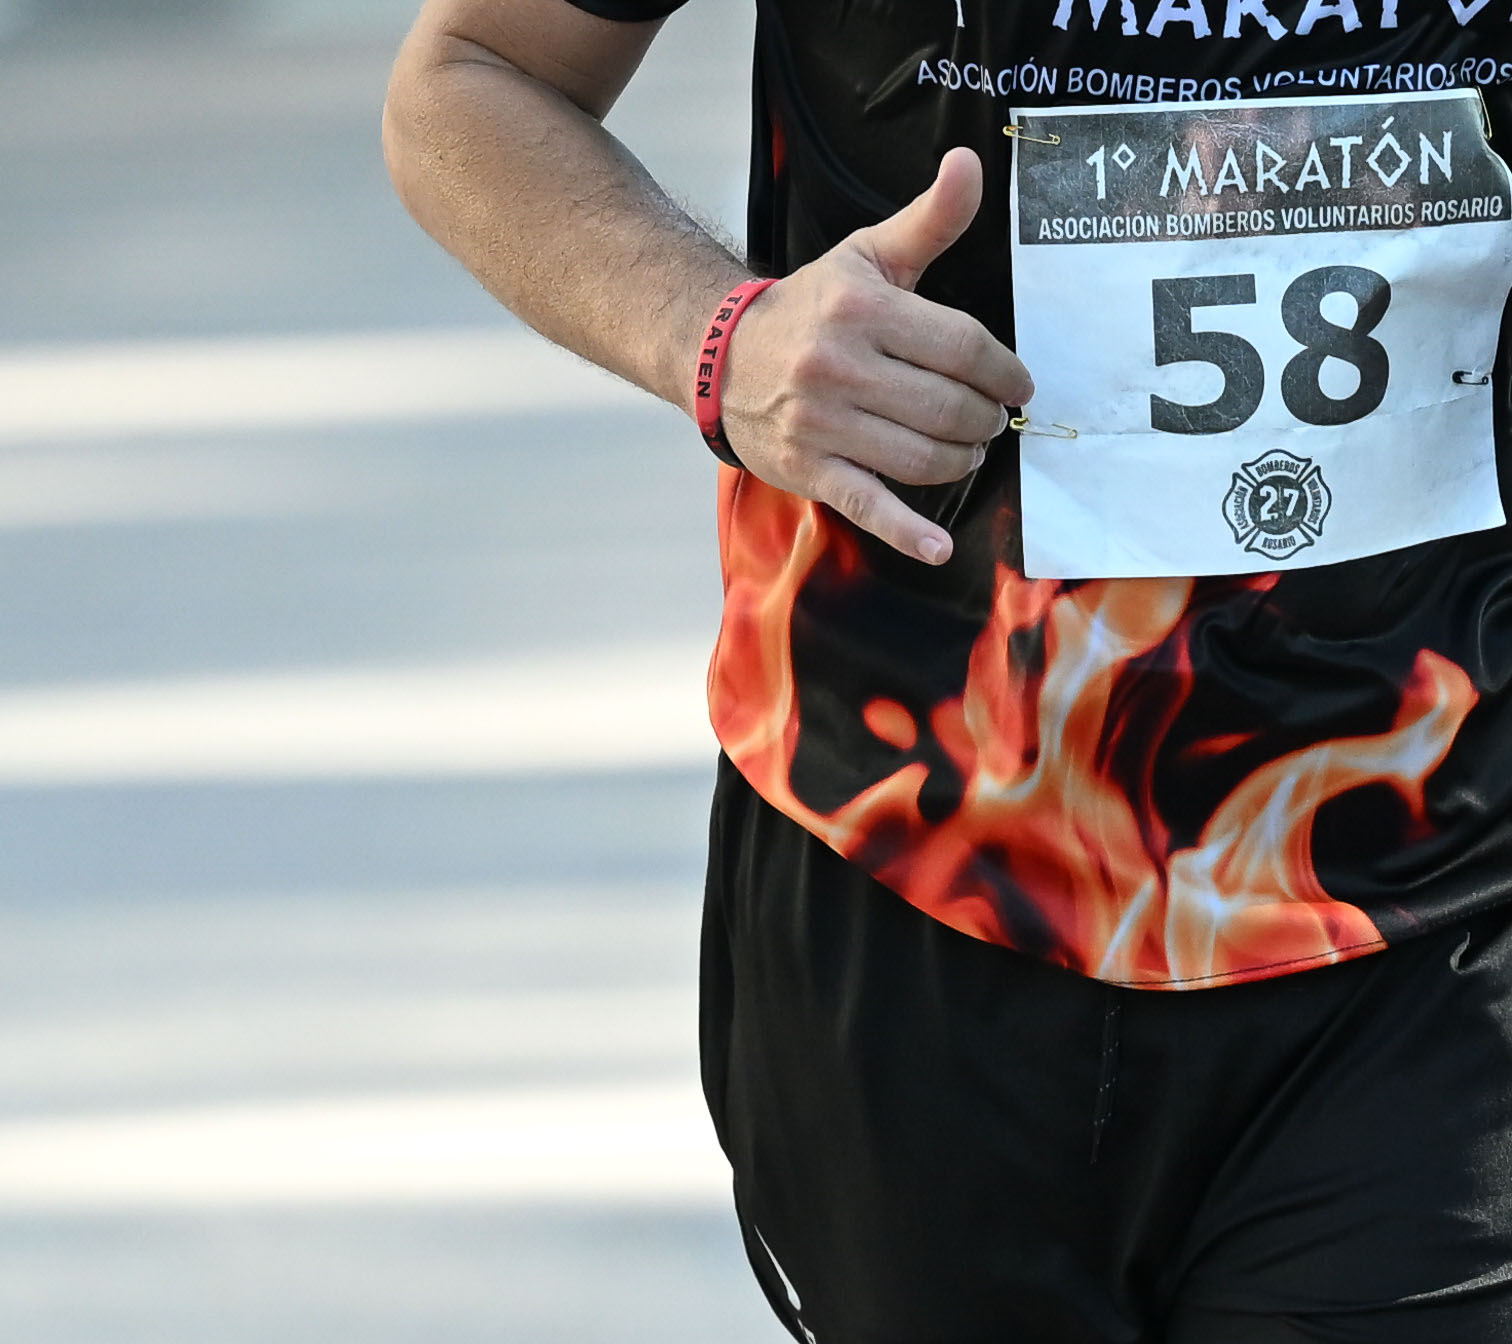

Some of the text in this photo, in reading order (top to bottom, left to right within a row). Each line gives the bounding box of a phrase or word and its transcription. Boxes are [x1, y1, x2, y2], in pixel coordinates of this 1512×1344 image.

[917, 56, 1058, 98] ASOCIACIÓN
[1066, 67, 1243, 103] BOMBEROS
[1159, 115, 1453, 199] MARATÓN
[1038, 195, 1503, 240] ASOCIACIÓN BOMBEROS VOLUNTARIOS ROSARIO
[1150, 265, 1392, 436] 58
[1259, 485, 1299, 522] 27
